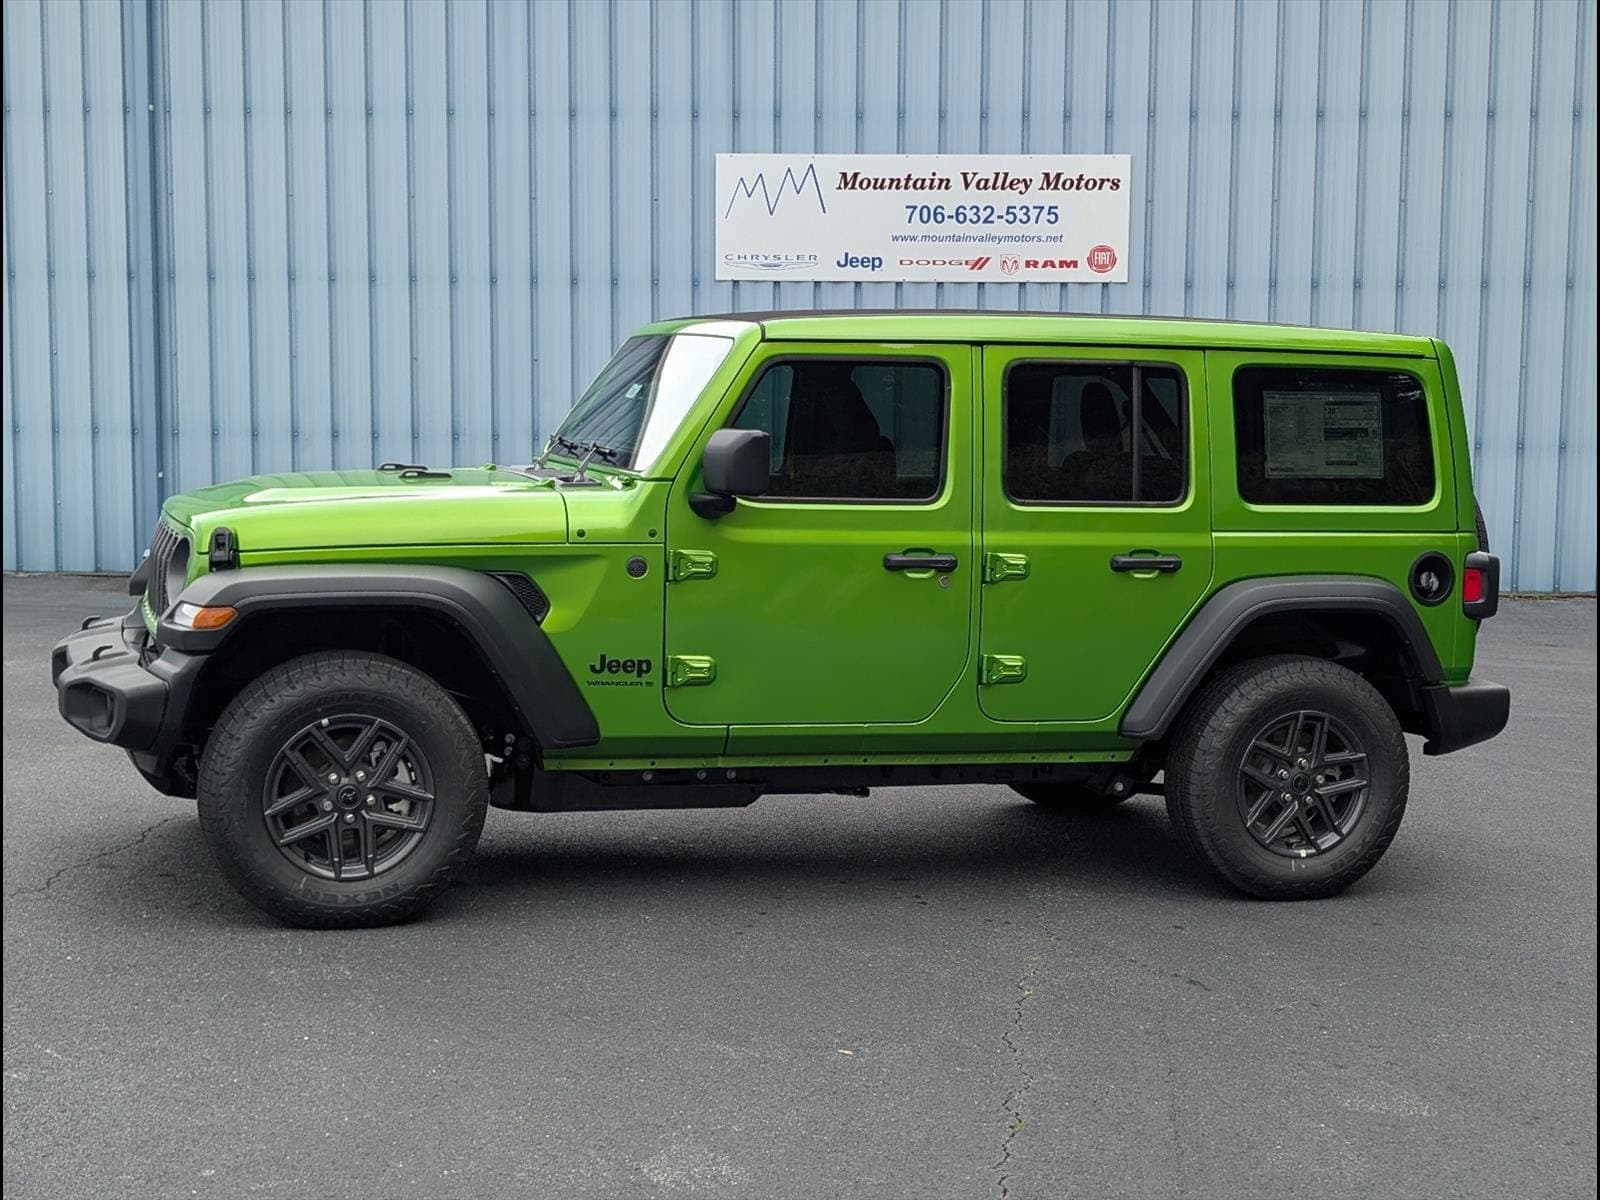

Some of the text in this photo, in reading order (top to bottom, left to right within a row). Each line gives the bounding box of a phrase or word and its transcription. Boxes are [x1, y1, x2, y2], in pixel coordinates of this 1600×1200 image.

[836, 172, 1121, 195] Mountain Valley Motors
[905, 205, 1060, 225] 706-632-5375
[891, 233, 1064, 244] www.mountainvalleymotors.net
[724, 254, 818, 262] CHRYSLER
[836, 252, 883, 271] Jeep
[1024, 259, 1078, 269] RAM
[1094, 251, 1111, 265] FIAT
[589, 653, 652, 678] Jeep
